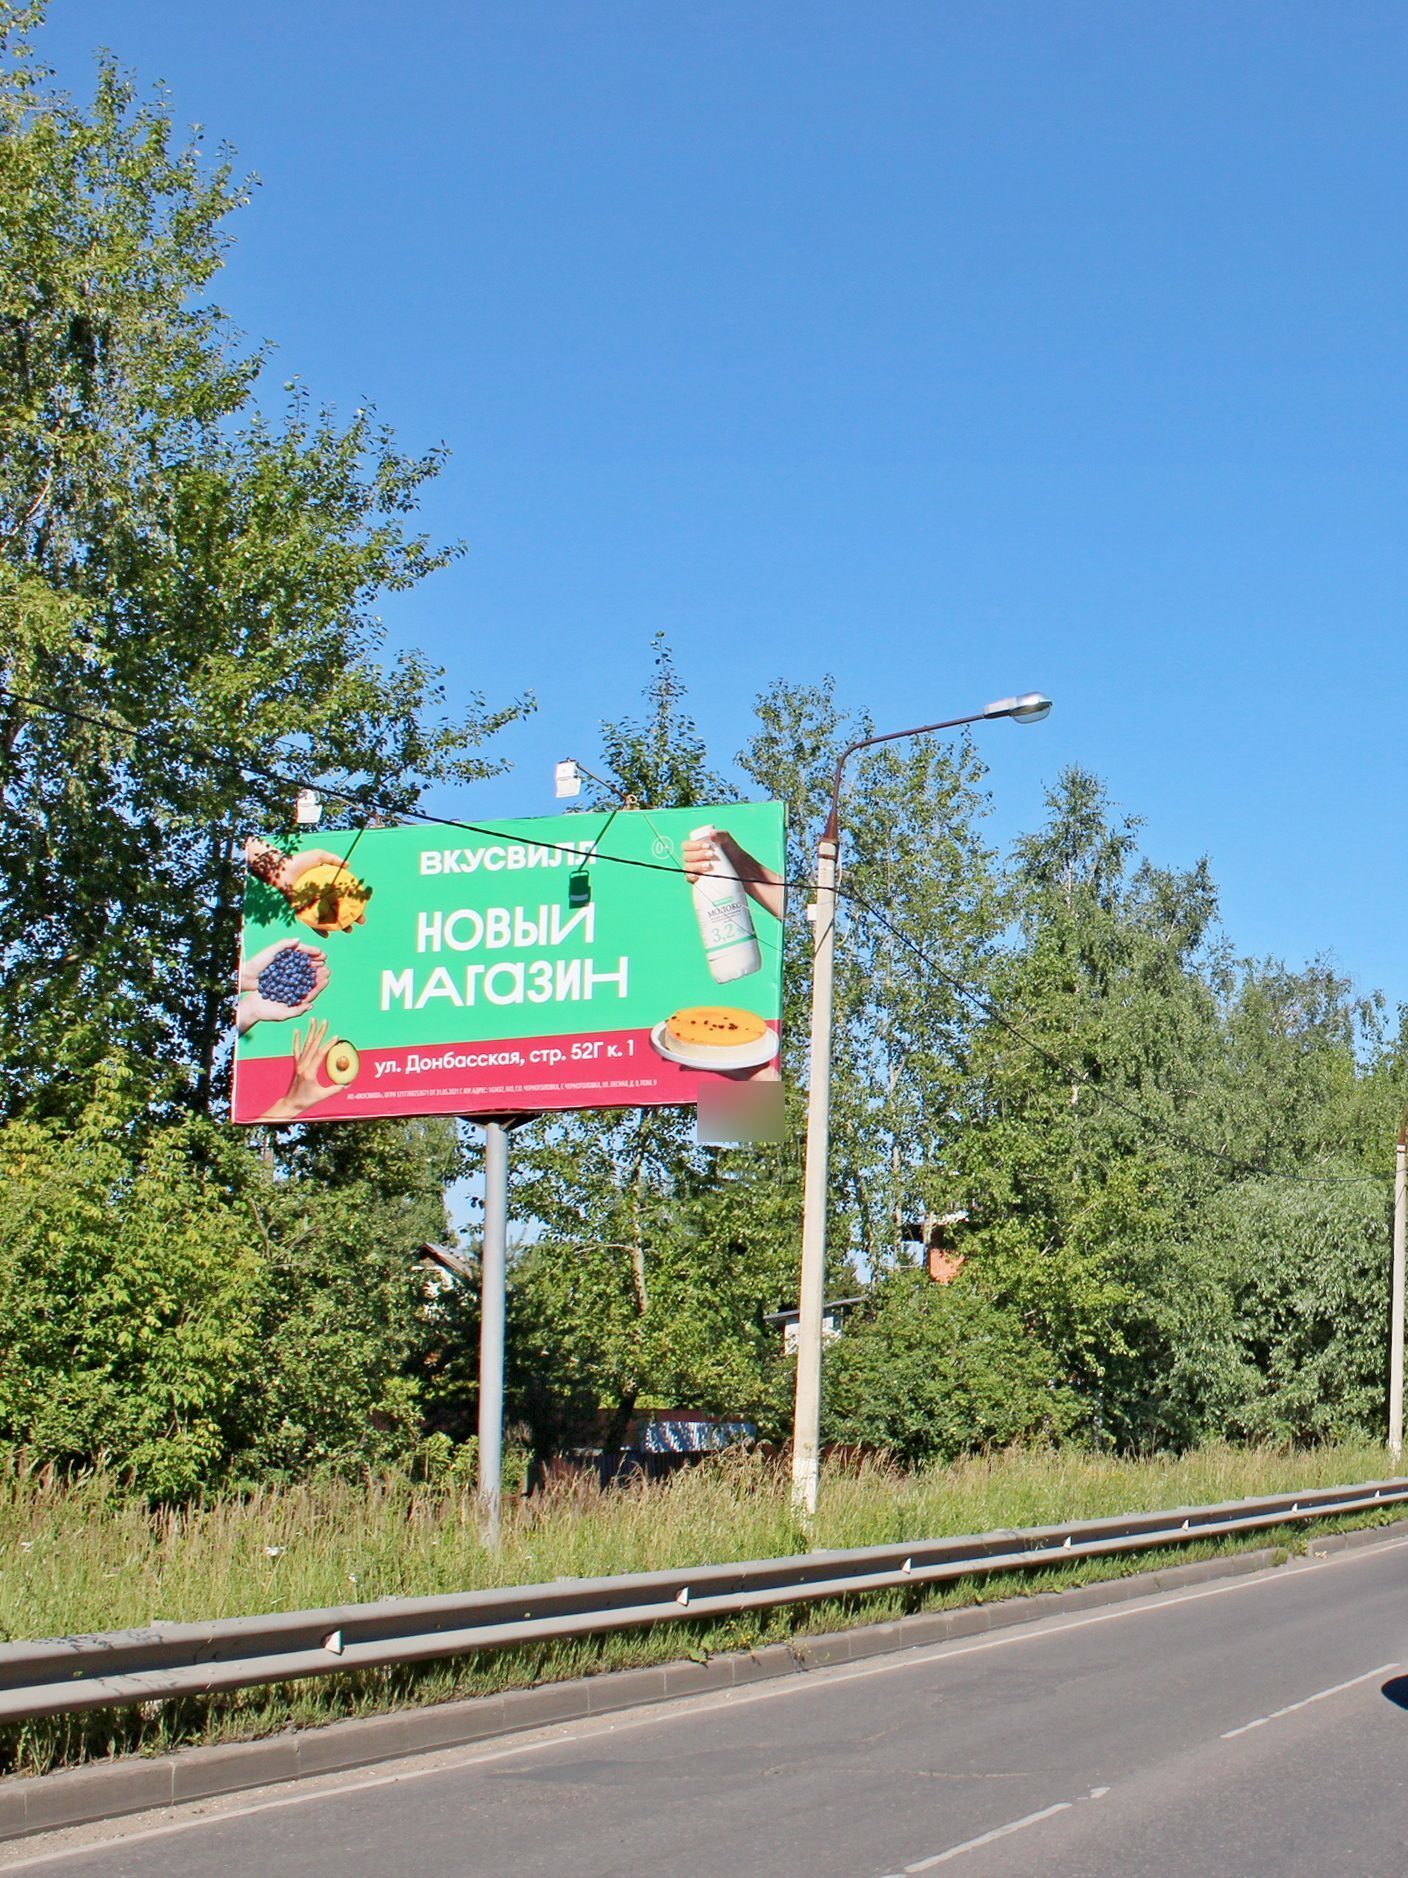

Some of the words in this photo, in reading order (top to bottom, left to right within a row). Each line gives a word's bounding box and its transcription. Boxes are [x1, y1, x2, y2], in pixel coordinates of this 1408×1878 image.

[420, 840, 597, 875] ВКУСВИЛЛ
[417, 895, 595, 953] НОВЫЙ
[374, 1059, 401, 1078] ул.
[405, 1051, 525, 1074] Донбасская,
[529, 1047, 566, 1065] стр.
[571, 1041, 604, 1060] 52Г
[607, 1046, 623, 1058] к.
[627, 1039, 635, 1056] 1
